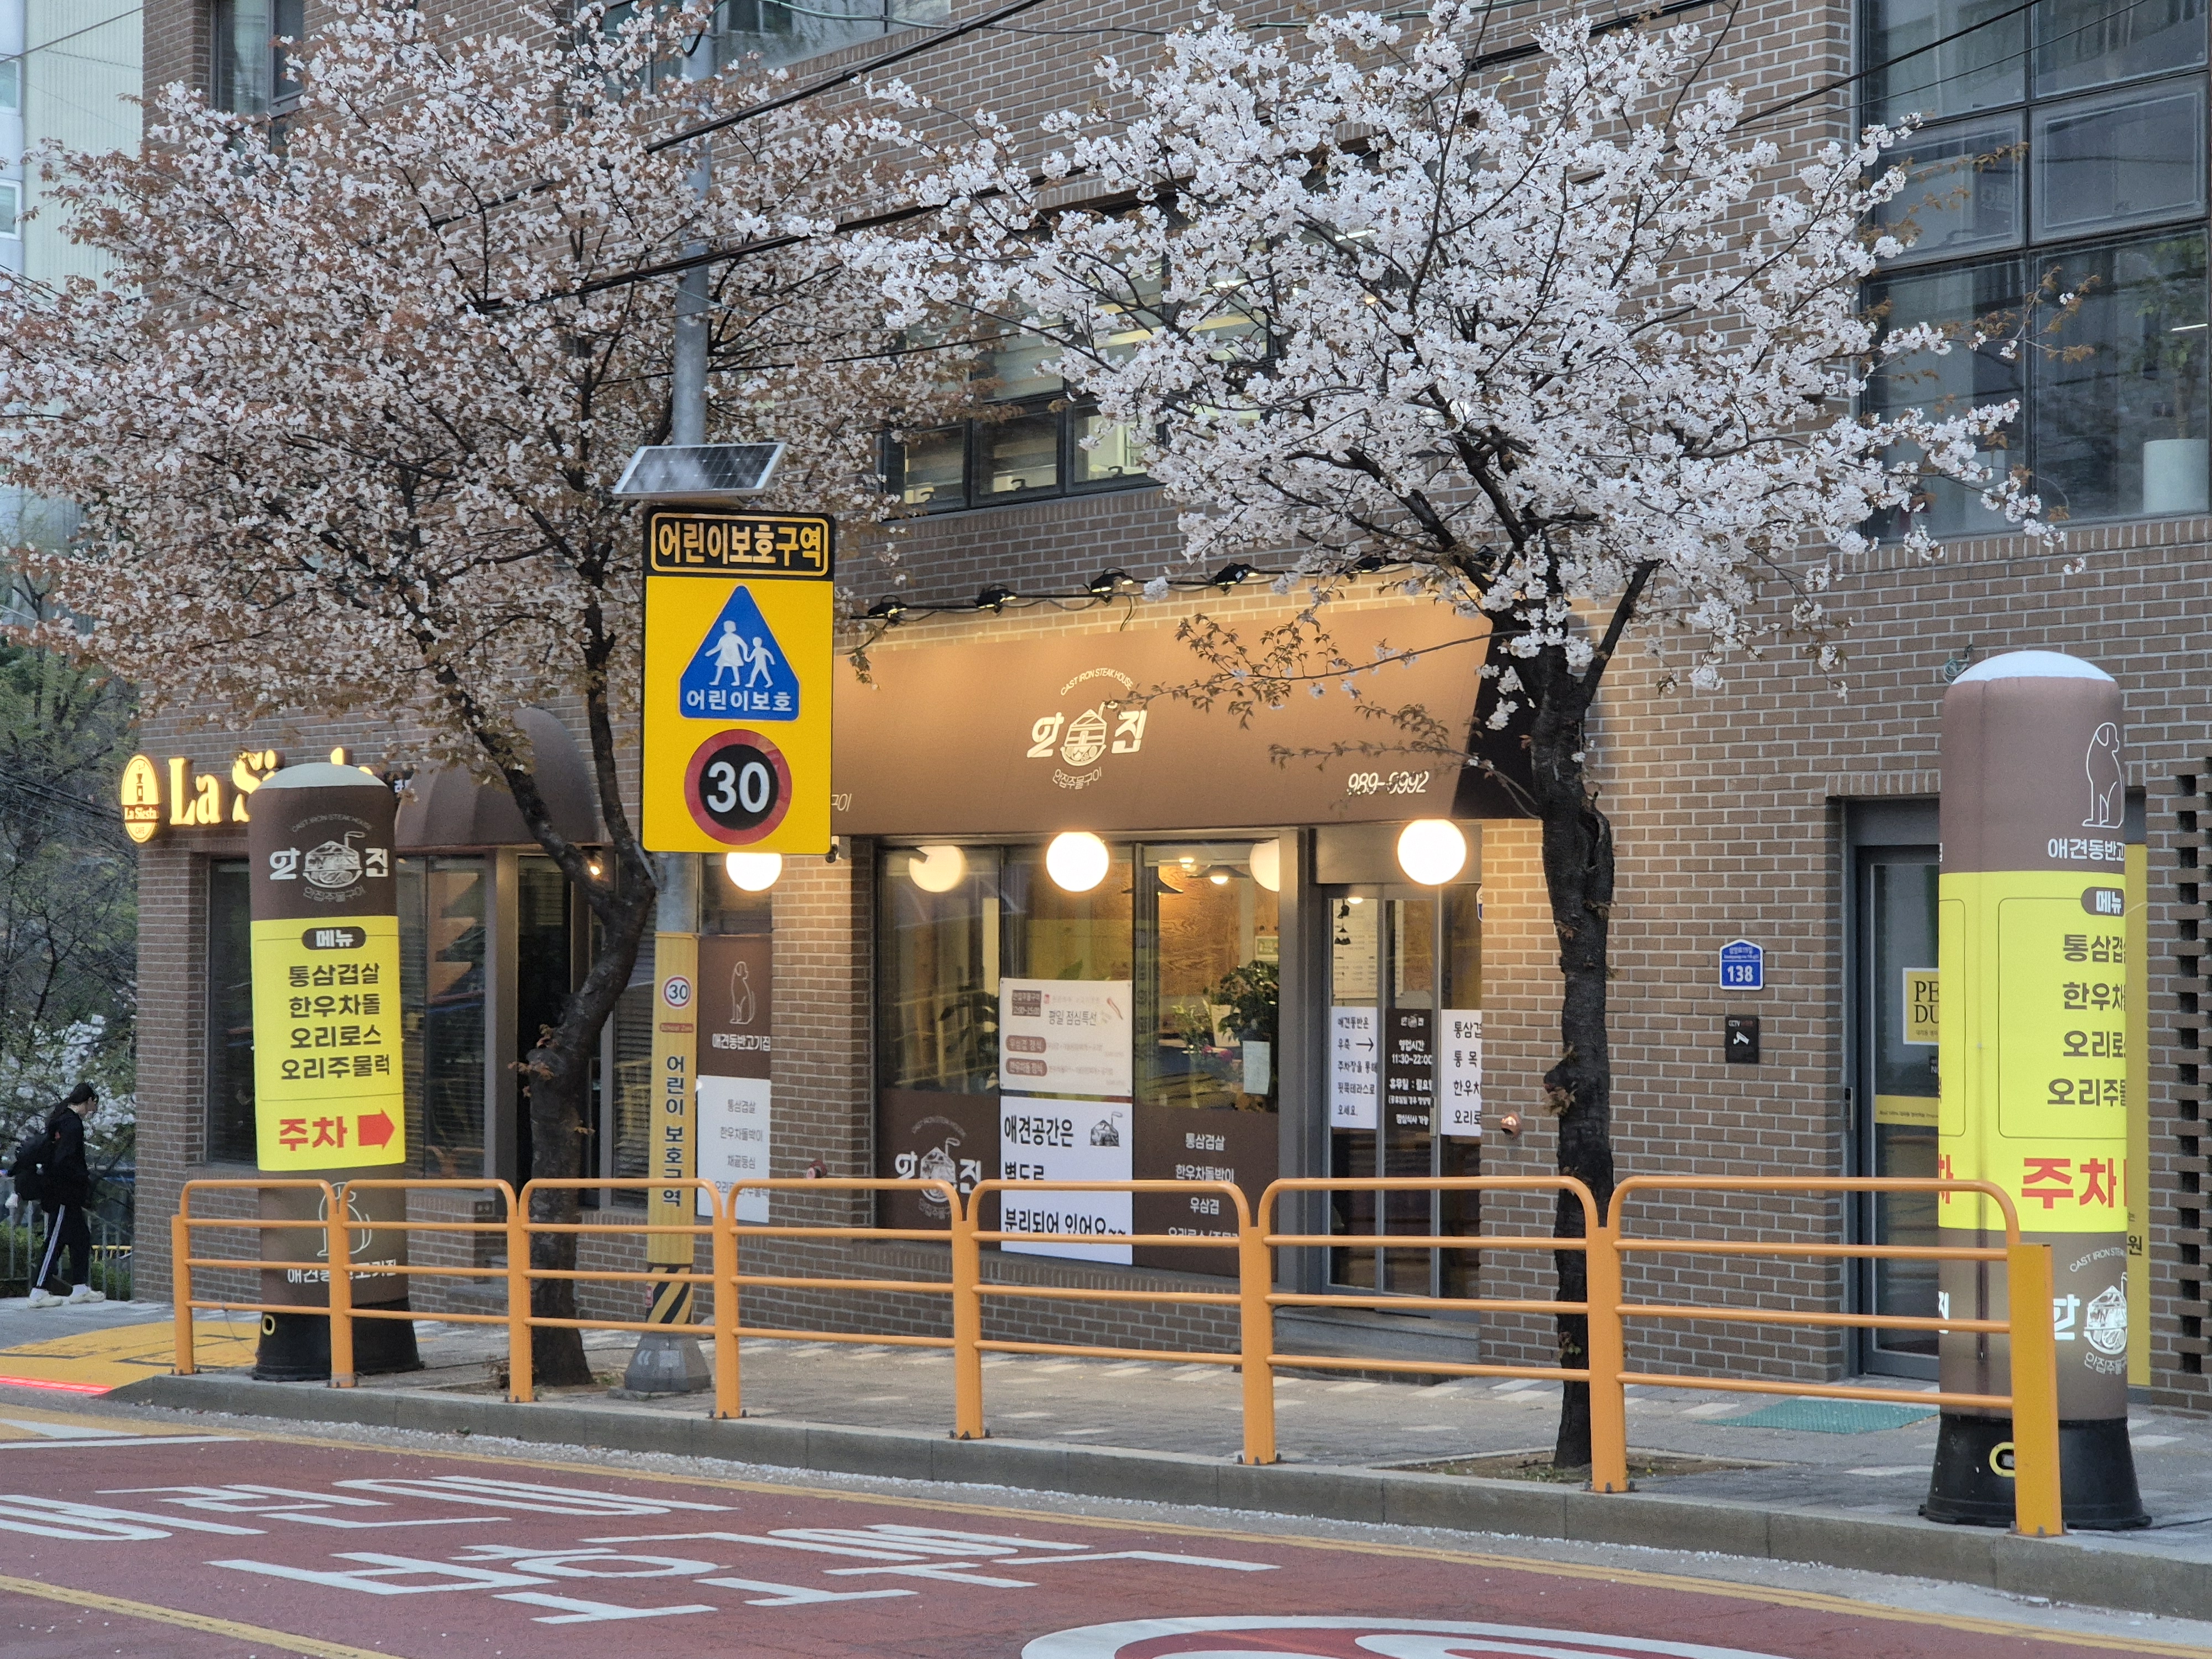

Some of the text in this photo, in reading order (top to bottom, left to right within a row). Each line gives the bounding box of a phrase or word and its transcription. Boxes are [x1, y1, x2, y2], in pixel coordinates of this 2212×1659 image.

[658, 521, 822, 567] 어린이보호구역
[1061, 667, 1133, 695] CAST IRON STEAK HOUSE
[686, 688, 793, 712] 어린이보호
[706, 761, 771, 813] 30
[1052, 766, 1102, 790] 안집주물구이
[168, 757, 222, 826] La
[124, 807, 157, 820] La Siesta
[2095, 890, 2122, 915] 메뉴
[316, 930, 354, 948] 메뉴
[2063, 933, 2126, 964] 통삼겹
[288, 962, 380, 988] 통삼겹살
[1727, 965, 1754, 983] 138
[669, 983, 689, 1001] 30
[2063, 982, 2126, 1011] 한우차
[289, 993, 380, 1018] 한우차돌
[1066, 1010, 1097, 1026] 점심특선
[290, 1024, 381, 1048] 오리로스
[712, 1033, 771, 1052] 애견동반고기집
[1399, 1039, 1425, 1052] 영업시간
[281, 1053, 390, 1079] 오리주물럭
[728, 1099, 756, 1114] 통삼겹살
[279, 1115, 348, 1152] 주차
[662, 1056, 685, 1208] 어린이 보호구역
[721, 1126, 763, 1142] 한우차돌박이
[1004, 1115, 1074, 1147] 애견공간은
[1185, 1133, 1225, 1151] 통삼겹살
[1175, 1163, 1235, 1183] 한우차돌박이
[2021, 1157, 2117, 1209] 주차
[1190, 1197, 1220, 1215] 우삼겹
[2070, 1254, 2091, 1272] CAST
[2093, 1248, 2110, 1261] IRON
[0, 1475, 740, 1541] 어린이
[204, 1524, 1284, 1624] 보호구역
